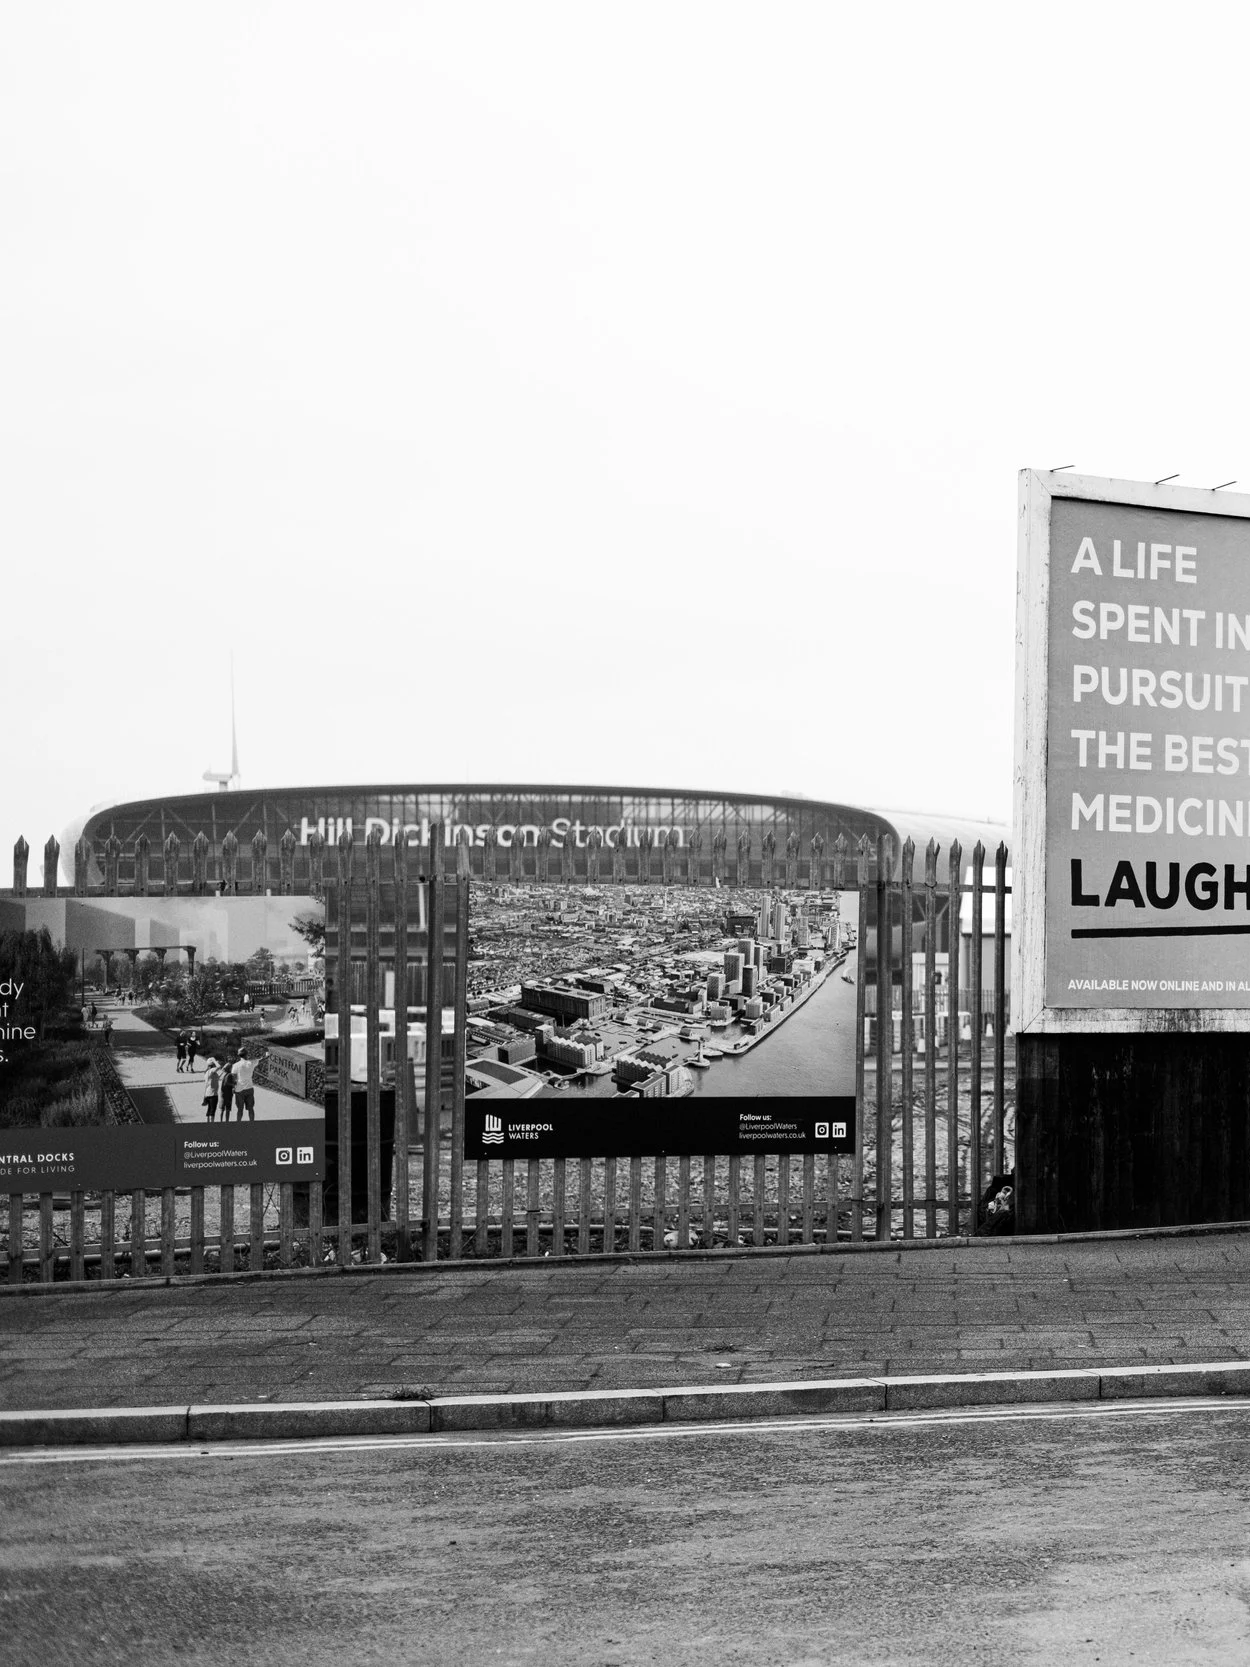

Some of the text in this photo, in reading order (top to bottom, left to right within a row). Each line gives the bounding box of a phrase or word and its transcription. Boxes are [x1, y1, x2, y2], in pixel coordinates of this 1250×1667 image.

[1070, 536, 1198, 584] A LIFE
[1071, 599, 1206, 647] SPENT
[1072, 664, 1249, 713] PURSUIT
[1070, 729, 1153, 771] THE
[301, 816, 353, 847] Hill
[0, 977, 24, 1000] dy
[1067, 979, 1129, 991] AVAILABLE
[1131, 979, 1158, 991] NOW
[1159, 980, 1200, 992] ONLINE
[1200, 980, 1224, 992] AND
[1225, 981, 1236, 992] IN
[739, 1113, 762, 1121] Follow
[508, 1123, 554, 1132] LIVERPOOL
[739, 1122, 798, 1132] @LiverpoolWaters
[508, 1132, 540, 1140] WATERS
[738, 1131, 807, 1141] liverpoolwaters.co.uk
[183, 1140, 219, 1149] Follow us:
[37, 1152, 75, 1163] DOCKS
[183, 1149, 248, 1160] @LiverpoolWaters
[0, 1164, 75, 1176] DE FOR LIVING
[183, 1158, 258, 1170] liverpoolwaters.co.uk
